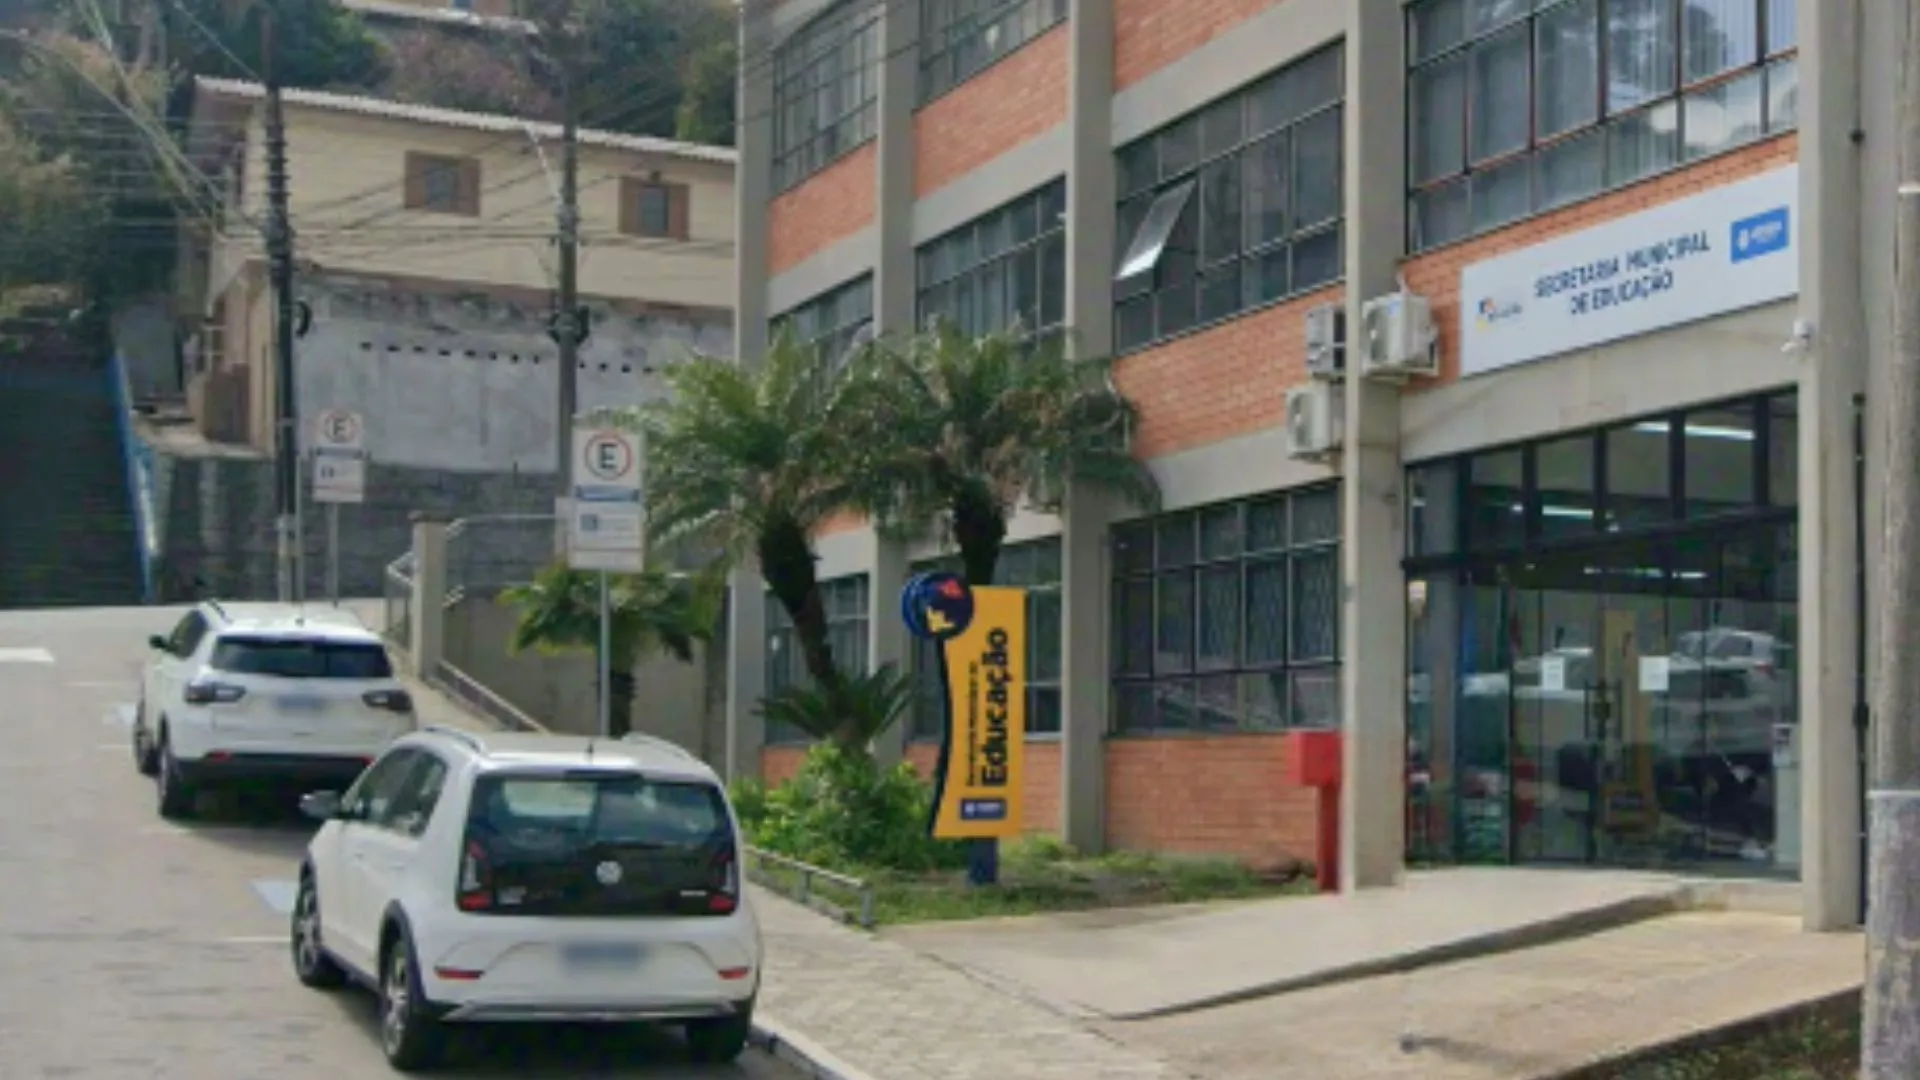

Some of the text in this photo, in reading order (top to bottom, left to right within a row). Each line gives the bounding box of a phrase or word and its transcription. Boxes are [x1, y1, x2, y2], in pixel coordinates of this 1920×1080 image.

[1534, 257, 1619, 298] SECRETARIA
[1626, 231, 1710, 272] MUNICIPAL
[1570, 266, 1673, 315] DE EDUCAÇÃO
[600, 443, 617, 469] E
[981, 627, 1013, 786] Educação
